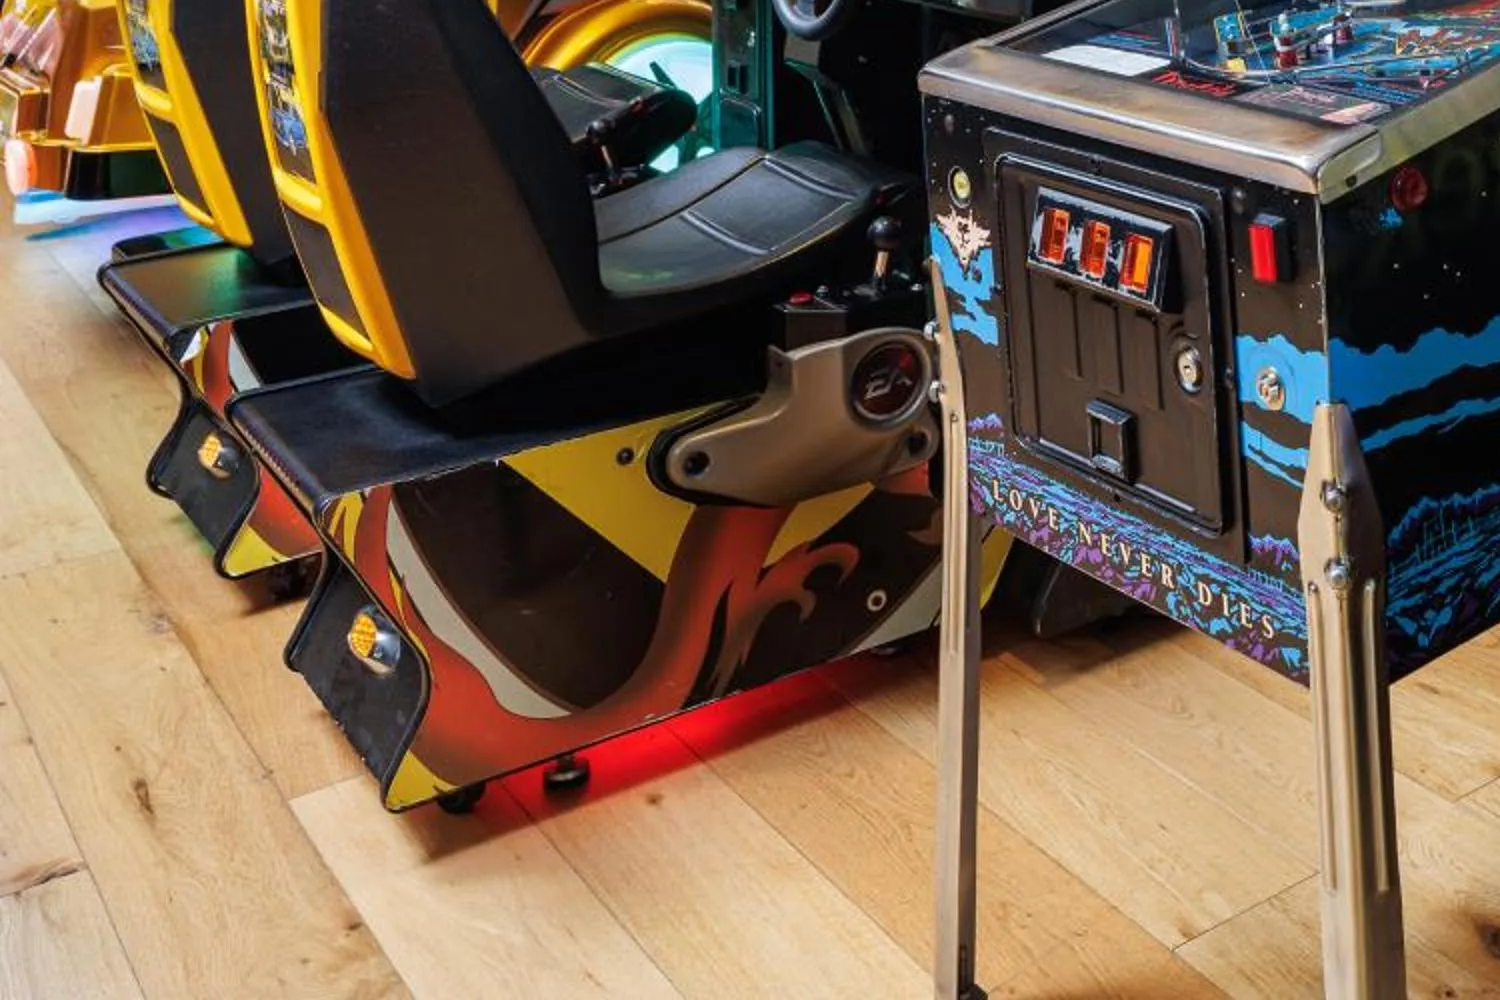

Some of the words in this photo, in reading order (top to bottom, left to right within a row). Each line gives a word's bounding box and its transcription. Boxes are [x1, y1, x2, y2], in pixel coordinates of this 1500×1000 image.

[991, 478, 1061, 533] LOVE
[1077, 524, 1176, 591] NEVER
[1197, 583, 1278, 641] DIES
